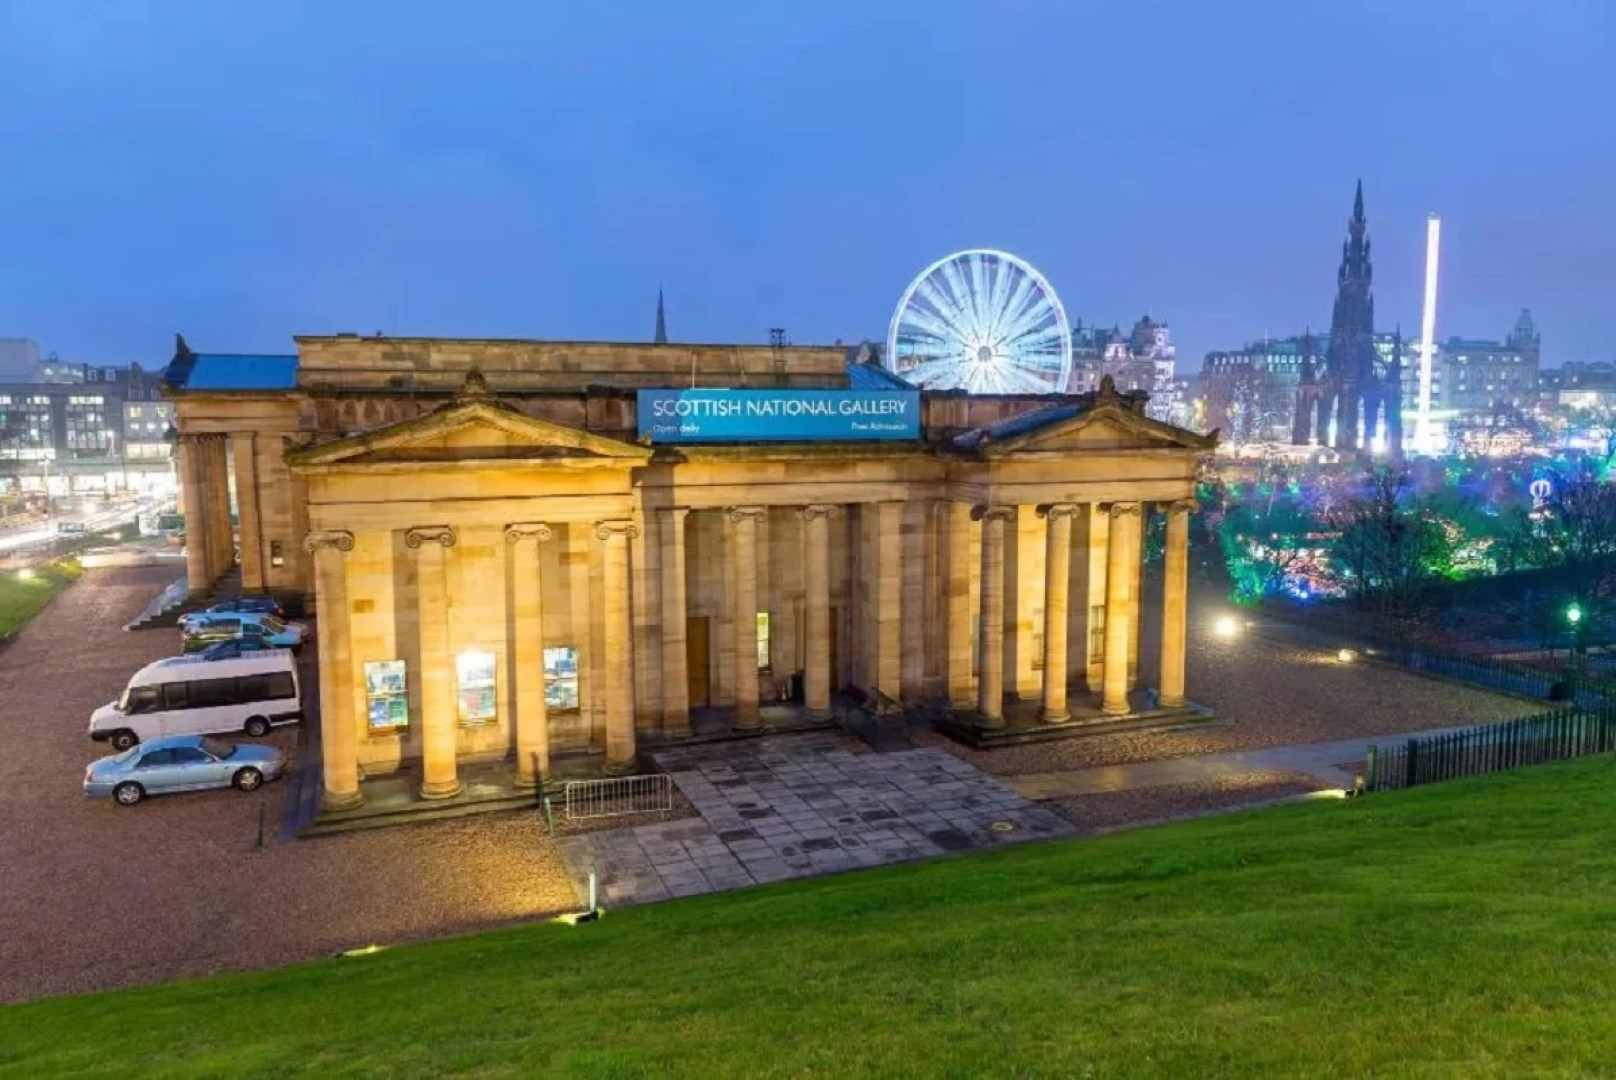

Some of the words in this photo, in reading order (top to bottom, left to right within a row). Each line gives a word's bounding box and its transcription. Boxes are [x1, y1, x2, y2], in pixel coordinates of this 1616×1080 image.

[653, 400, 741, 416] SCOTTISH
[747, 400, 837, 416] NATIONAL
[839, 400, 907, 414] GALLERY
[653, 424, 677, 434] Open
